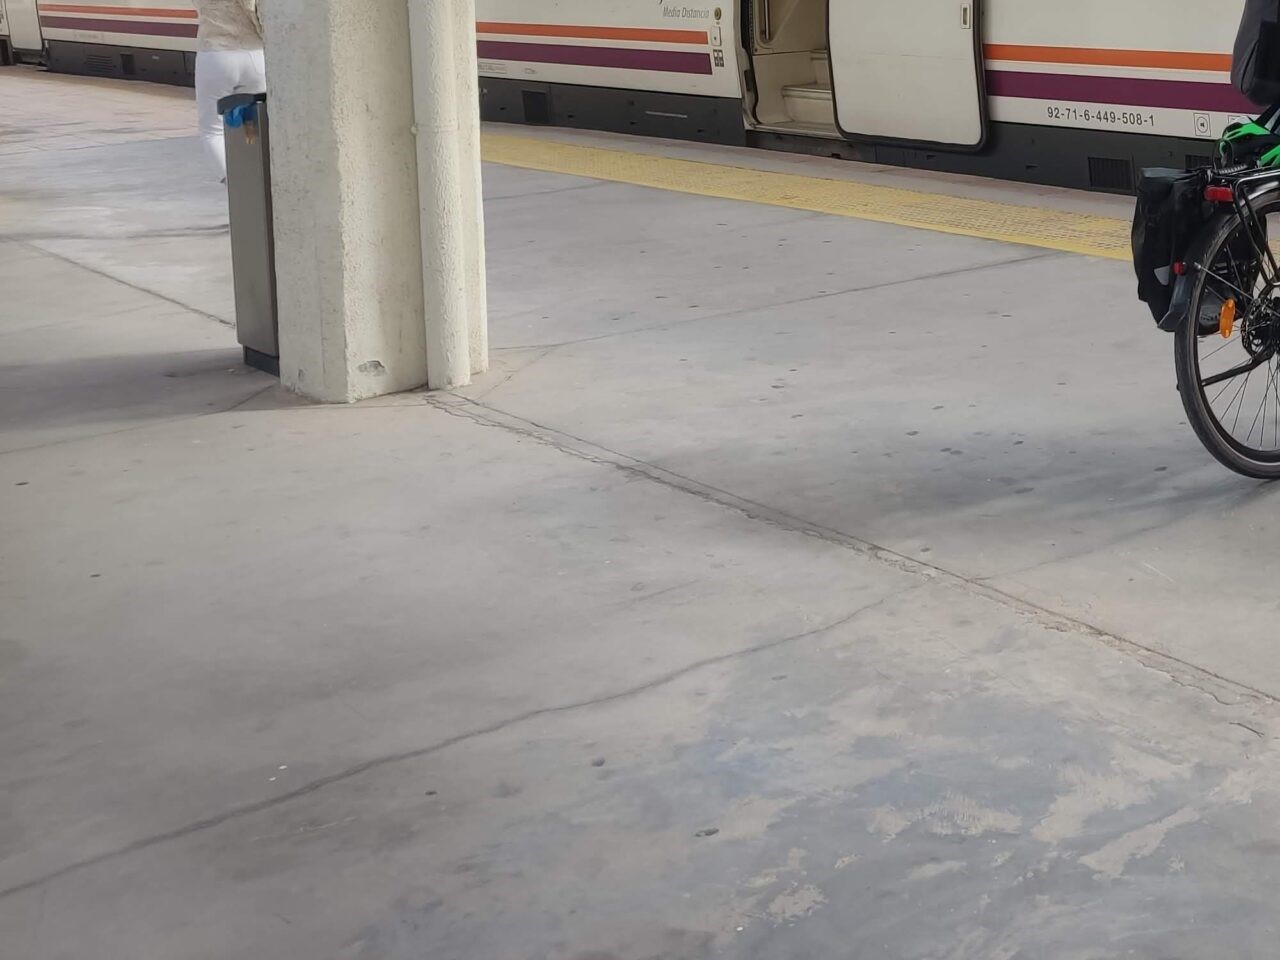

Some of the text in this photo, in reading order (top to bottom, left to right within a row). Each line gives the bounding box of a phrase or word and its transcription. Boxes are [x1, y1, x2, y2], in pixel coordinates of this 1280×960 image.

[662, 6, 710, 19] Media Distancia
[1047, 106, 1155, 127] 92-71-6-449-508-1
